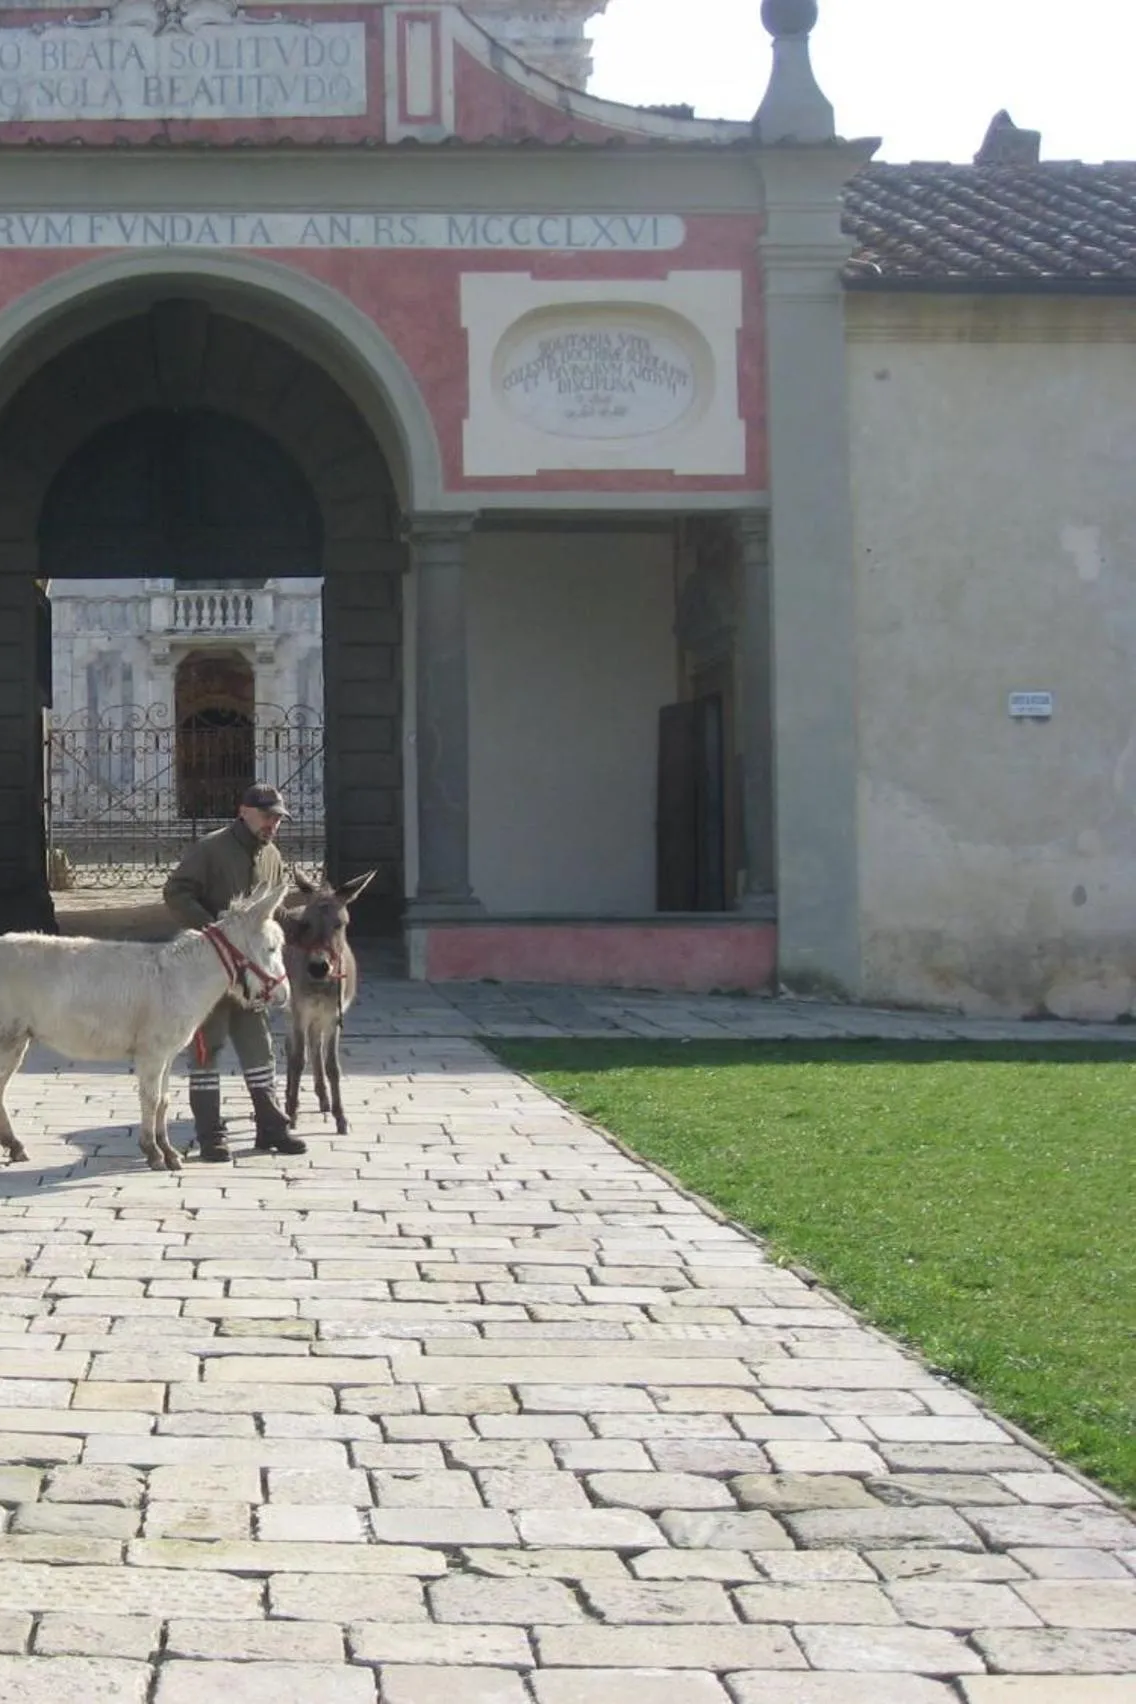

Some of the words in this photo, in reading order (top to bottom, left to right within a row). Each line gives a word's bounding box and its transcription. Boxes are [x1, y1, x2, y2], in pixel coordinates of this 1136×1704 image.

[41, 38, 147, 71] BEATA
[169, 35, 351, 70] SOLITVDO
[36, 77, 123, 108] SOLA
[143, 73, 352, 107] BEATITVDO
[88, 214, 273, 247] FVNDATA
[446, 214, 659, 247] MCCCLXVI
